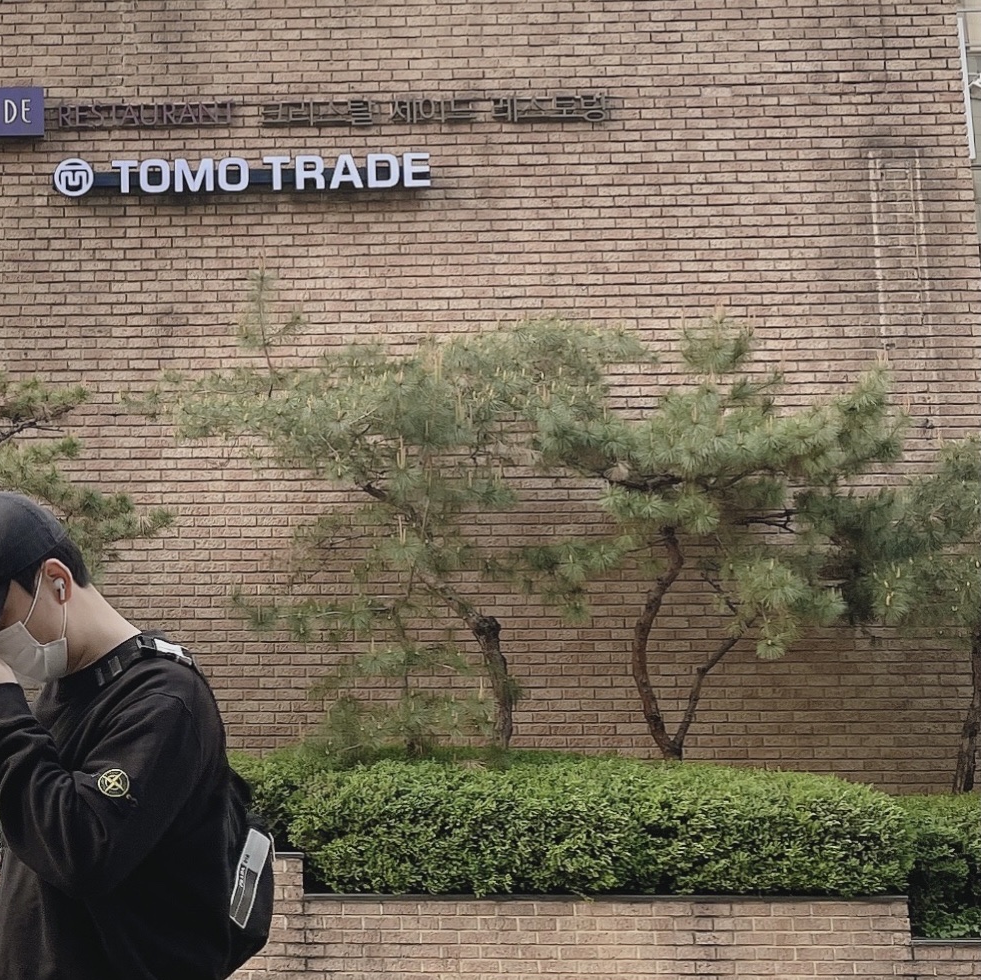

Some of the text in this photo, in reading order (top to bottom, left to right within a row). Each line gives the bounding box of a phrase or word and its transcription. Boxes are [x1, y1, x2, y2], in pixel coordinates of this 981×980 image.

[58, 101, 233, 127] RESTAURANT
[261, 100, 377, 126] 크리스탈
[491, 93, 607, 123] 레스토랑
[111, 152, 432, 194] TOMO TRADE
